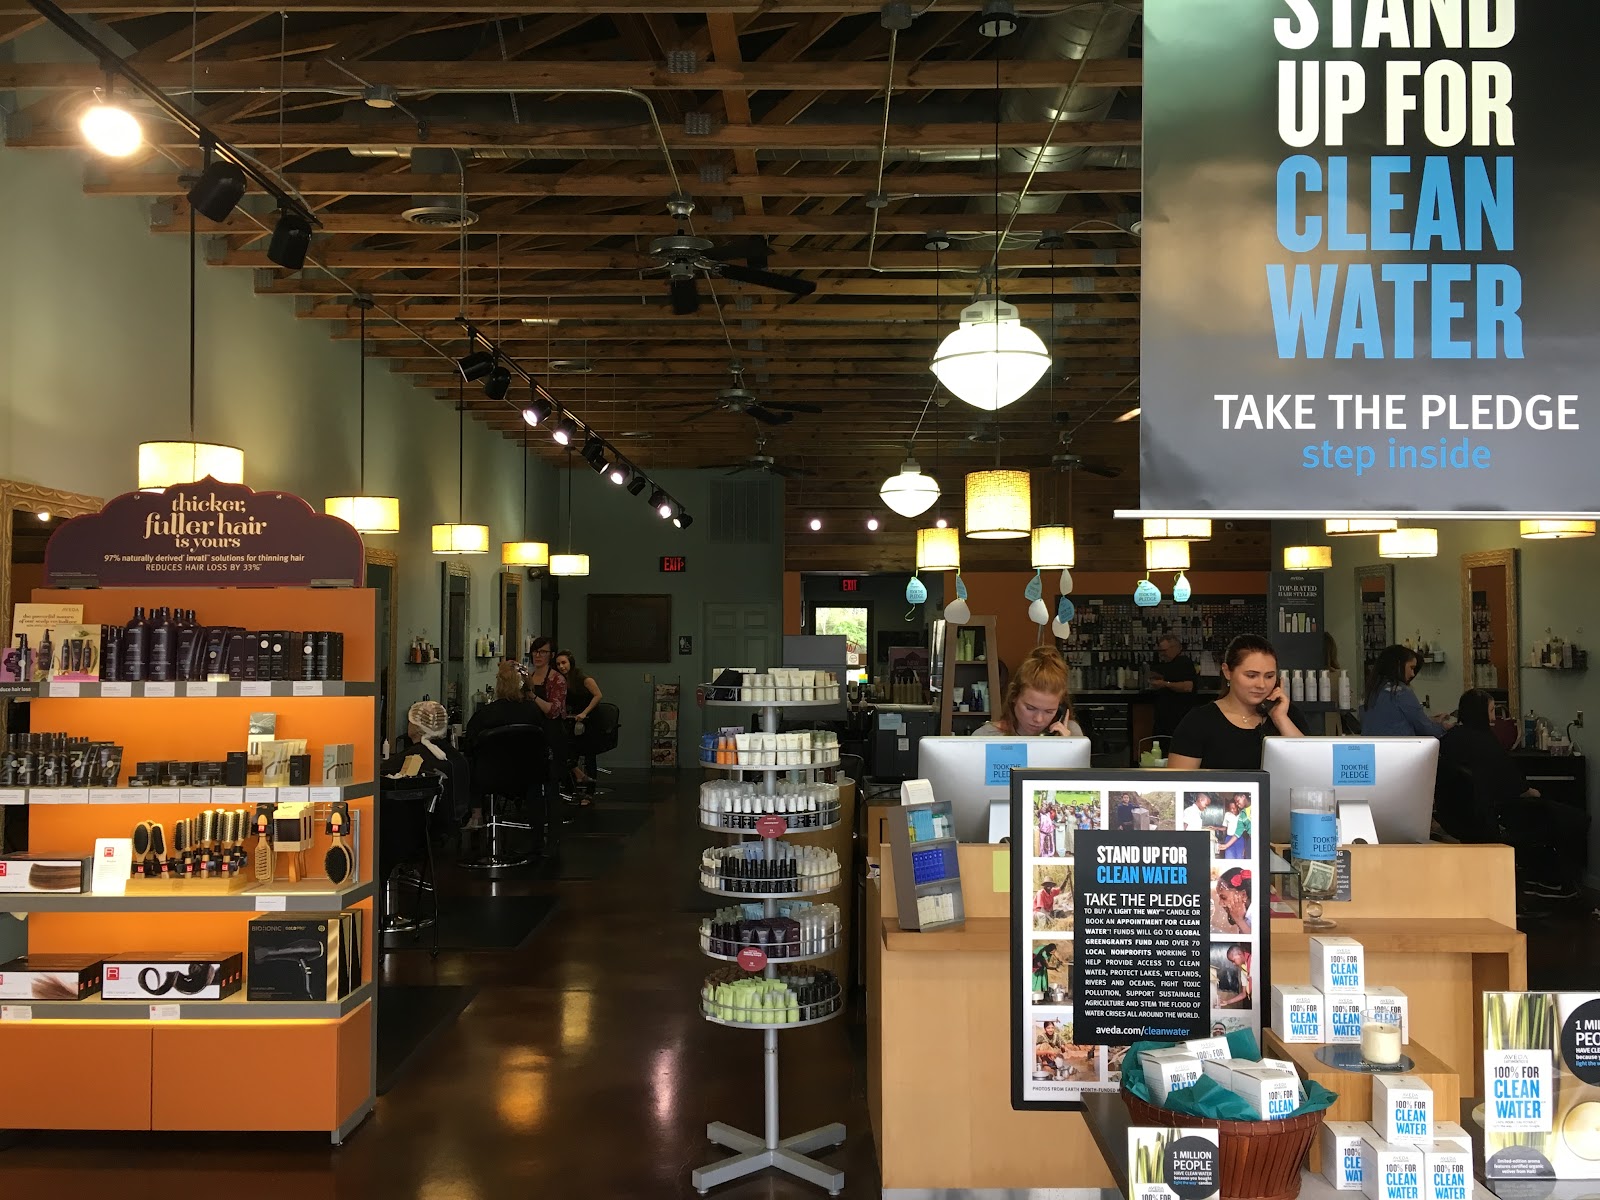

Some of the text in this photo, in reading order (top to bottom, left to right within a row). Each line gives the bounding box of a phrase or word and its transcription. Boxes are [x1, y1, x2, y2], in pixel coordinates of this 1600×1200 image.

[1273, 0, 1516, 49] STAND
[1278, 60, 1516, 147] UP FOR
[1276, 155, 1514, 253] CLEAN
[1266, 263, 1525, 359] WATER
[1214, 394, 1580, 430] TAKE THE PLEDGE
[1302, 437, 1491, 475] step inside
[172, 492, 246, 513] thicker,
[143, 512, 268, 539] fuller hair
[175, 534, 241, 553] is yours
[104, 554, 121, 562] 97%
[121, 554, 155, 563] naturally
[211, 554, 245, 562] solutions
[246, 554, 257, 562] for
[258, 554, 288, 564] thinning
[290, 554, 305, 562] hair
[663, 557, 682, 571] EXIT
[145, 563, 183, 571] REDUCES
[185, 563, 204, 571] HAIR
[206, 563, 228, 571] LOSS
[230, 563, 241, 571] BY
[842, 579, 858, 591] EXIT
[1340, 771, 1369, 779] PLEDGE
[1096, 845, 1187, 864] STAND UP FOR
[1096, 865, 1187, 884] CLEAN WATER
[1084, 893, 1201, 907] TAKE THE PLEDGE
[1330, 963, 1358, 974] CLEAN
[1332, 975, 1358, 986] WATER
[1290, 1012, 1317, 1024] CLEAN
[1332, 1013, 1360, 1024] CLEAN
[1095, 1025, 1190, 1037] aveda.com/cleanwater
[1291, 1024, 1318, 1035] WATER
[1334, 1025, 1360, 1036] WATER
[1575, 1020, 1581, 1030] 1
[1494, 1066, 1539, 1078] 100% FOR
[1269, 1090, 1293, 1100] 100% FOR
[1494, 1080, 1540, 1098] CLEAN
[1269, 1099, 1294, 1113] CLEAN
[1396, 1101, 1426, 1109] 100% FOR
[1495, 1100, 1541, 1118] WATER
[1395, 1109, 1426, 1122] CLEAN
[1396, 1123, 1426, 1135] WATER
[1174, 1160, 1211, 1170] PEOPLE
[1386, 1173, 1417, 1186] CLEAN
[1434, 1174, 1464, 1186] CLEAN
[1387, 1187, 1418, 1199] WATER
[1435, 1188, 1465, 1199] WATER
